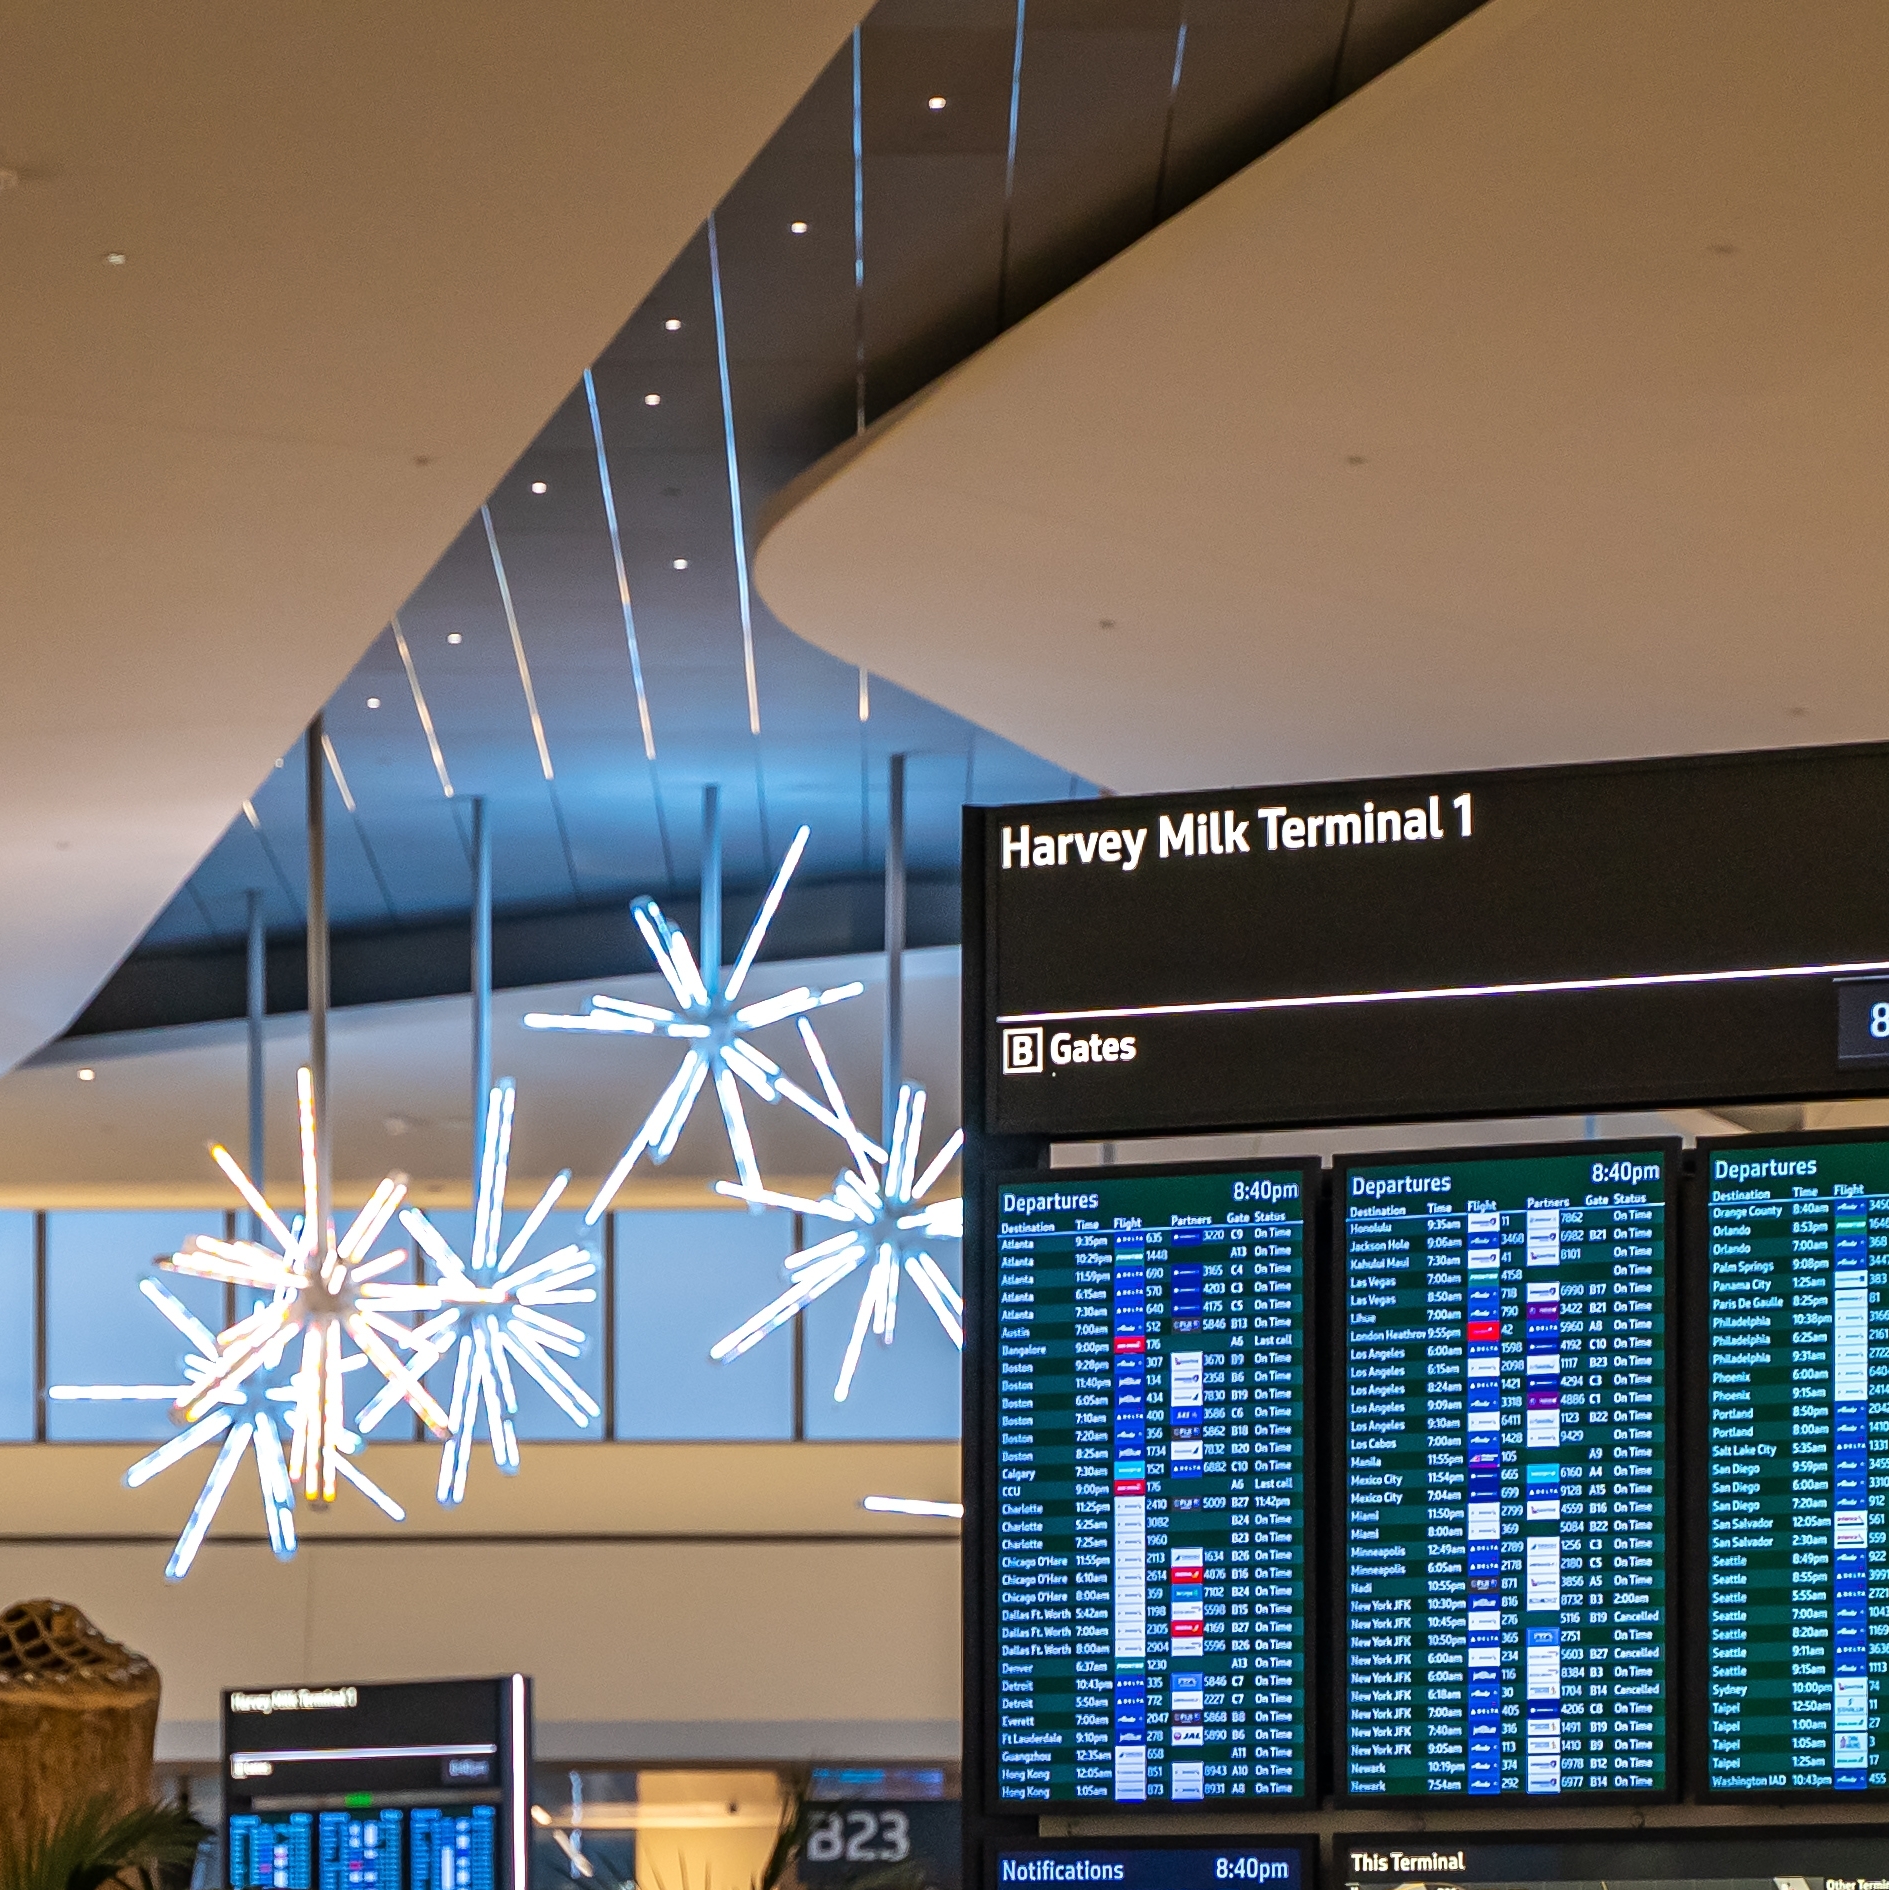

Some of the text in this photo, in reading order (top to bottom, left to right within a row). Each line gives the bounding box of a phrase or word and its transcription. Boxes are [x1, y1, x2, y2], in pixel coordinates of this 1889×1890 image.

[1002, 795, 1471, 871] Harvey Milk Terminal 1
[1009, 1033, 1136, 1066] B Gates
[1353, 1162, 1660, 1198] Departures 8:40pm
[1716, 1159, 1817, 1181] Departures
[1004, 1180, 1299, 1214] Departures 8:40pm
[1713, 1189, 1770, 1201] Destination
[1793, 1187, 1818, 1197] Time
[1833, 1184, 1864, 1196] Flight
[1350, 1194, 1646, 1218] Destination Time Flight Partners Gate Status
[1002, 1212, 1285, 1234] Destination Time Flight Partners Gate Status
[1713, 1408, 1753, 1420] Portland
[1614, 1611, 1659, 1622] Cancelled
[1713, 1682, 1832, 1697] Sydney 10:00pm
[1003, 1858, 1289, 1882] Notifications 8:40pm
[1351, 1851, 1465, 1871] This Terminal
[1826, 1879, 1855, 1890] Other
